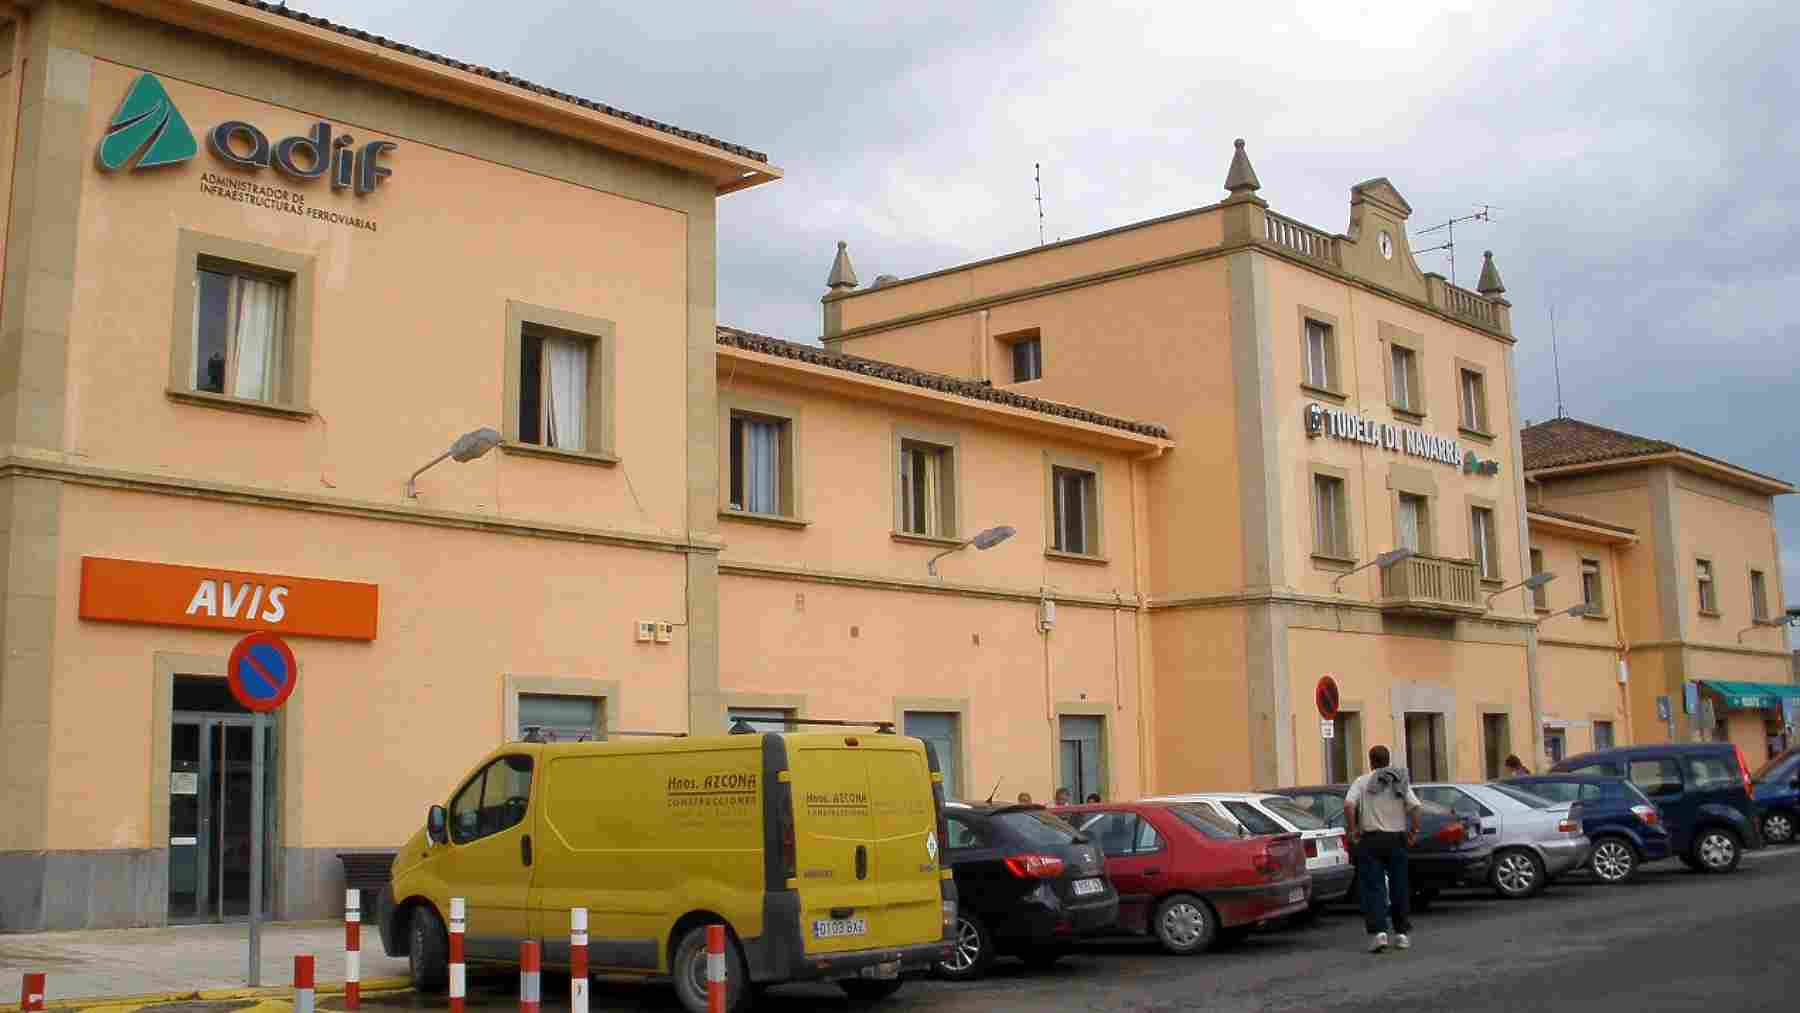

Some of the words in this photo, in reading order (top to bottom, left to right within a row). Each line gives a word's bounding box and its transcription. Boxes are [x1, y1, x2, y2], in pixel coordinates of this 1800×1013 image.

[209, 119, 398, 194] adif
[200, 172, 289, 199] ADMINISTRADOR
[291, 192, 305, 206] DE
[200, 183, 304, 216] INFRAESTRUCTURAS
[306, 207, 377, 232] FERROVIARIAS
[1328, 409, 1383, 448] TUDELA
[1384, 424, 1406, 451] DE
[1407, 428, 1462, 466] NAVARRA
[186, 579, 289, 624] AVIS
[704, 772, 757, 789] AZCONA
